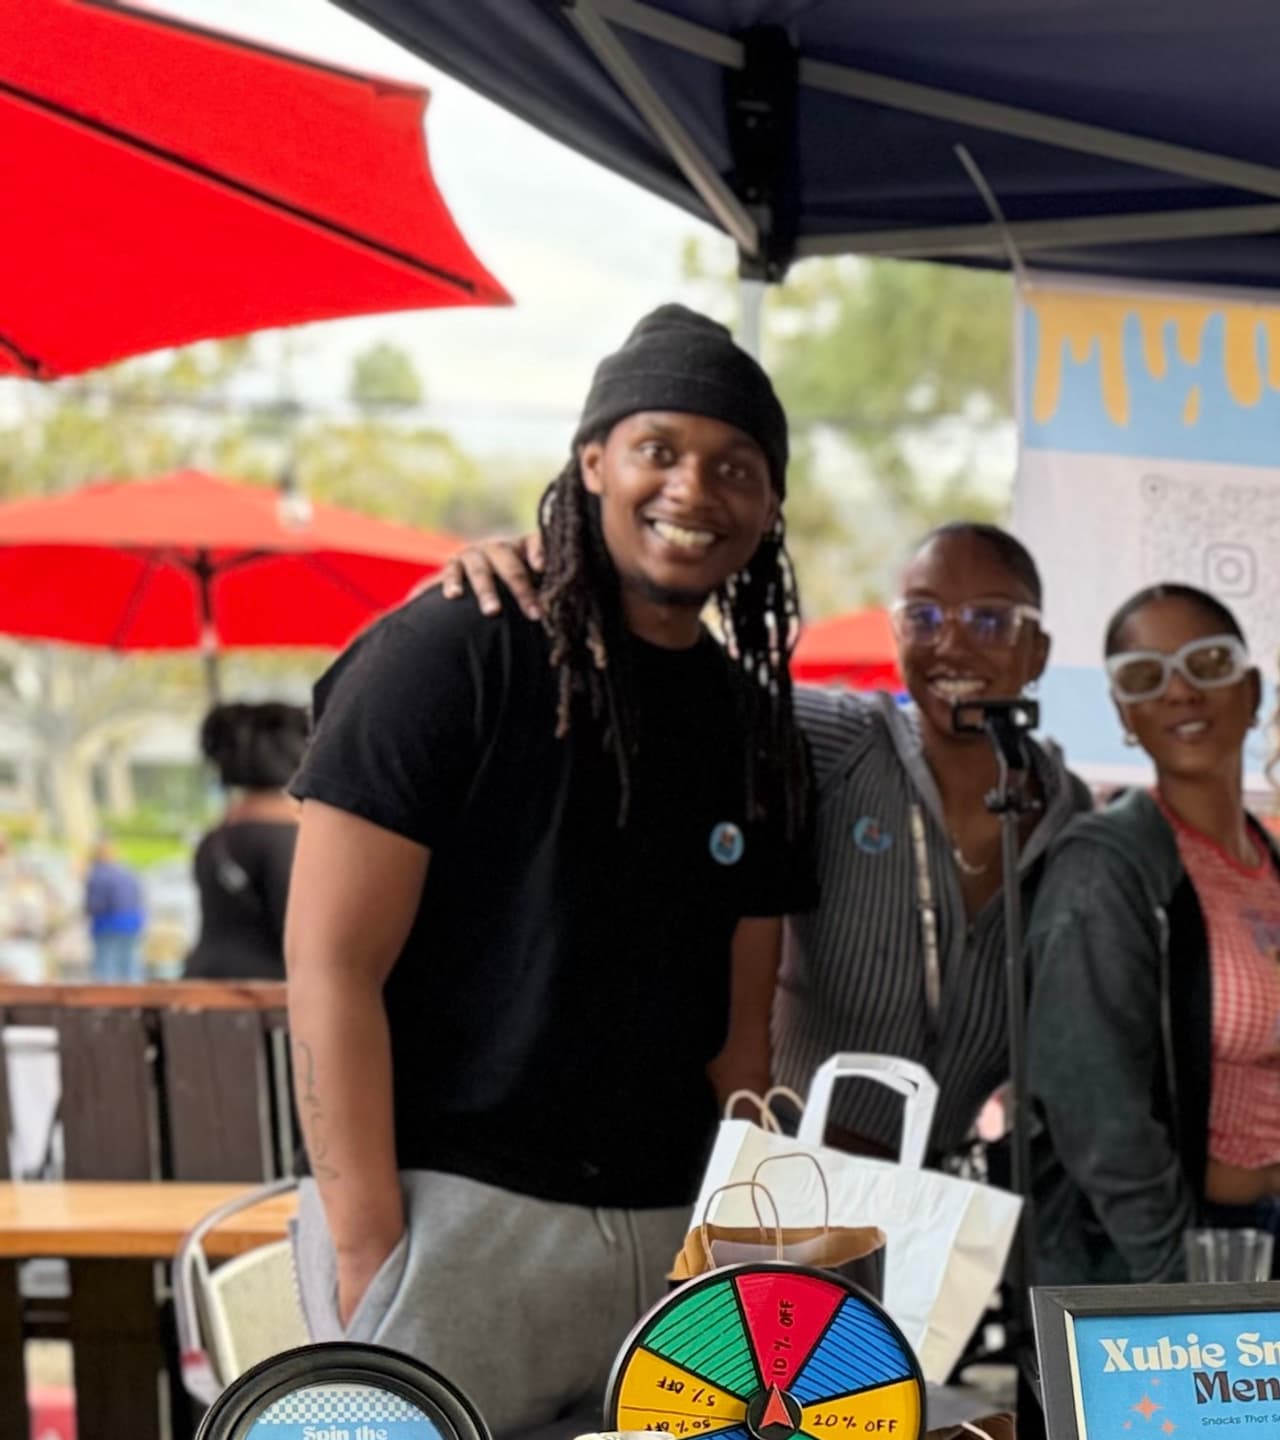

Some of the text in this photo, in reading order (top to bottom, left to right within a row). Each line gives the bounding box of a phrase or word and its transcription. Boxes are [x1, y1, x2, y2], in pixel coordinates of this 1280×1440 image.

[779, 1299, 794, 1327] OFF
[1099, 1331, 1227, 1374] Xubie
[656, 1376, 685, 1395] OFF
[864, 1419, 899, 1433] OFF
[1201, 1416, 1242, 1426] Snacks
[1244, 1414, 1269, 1424] That
